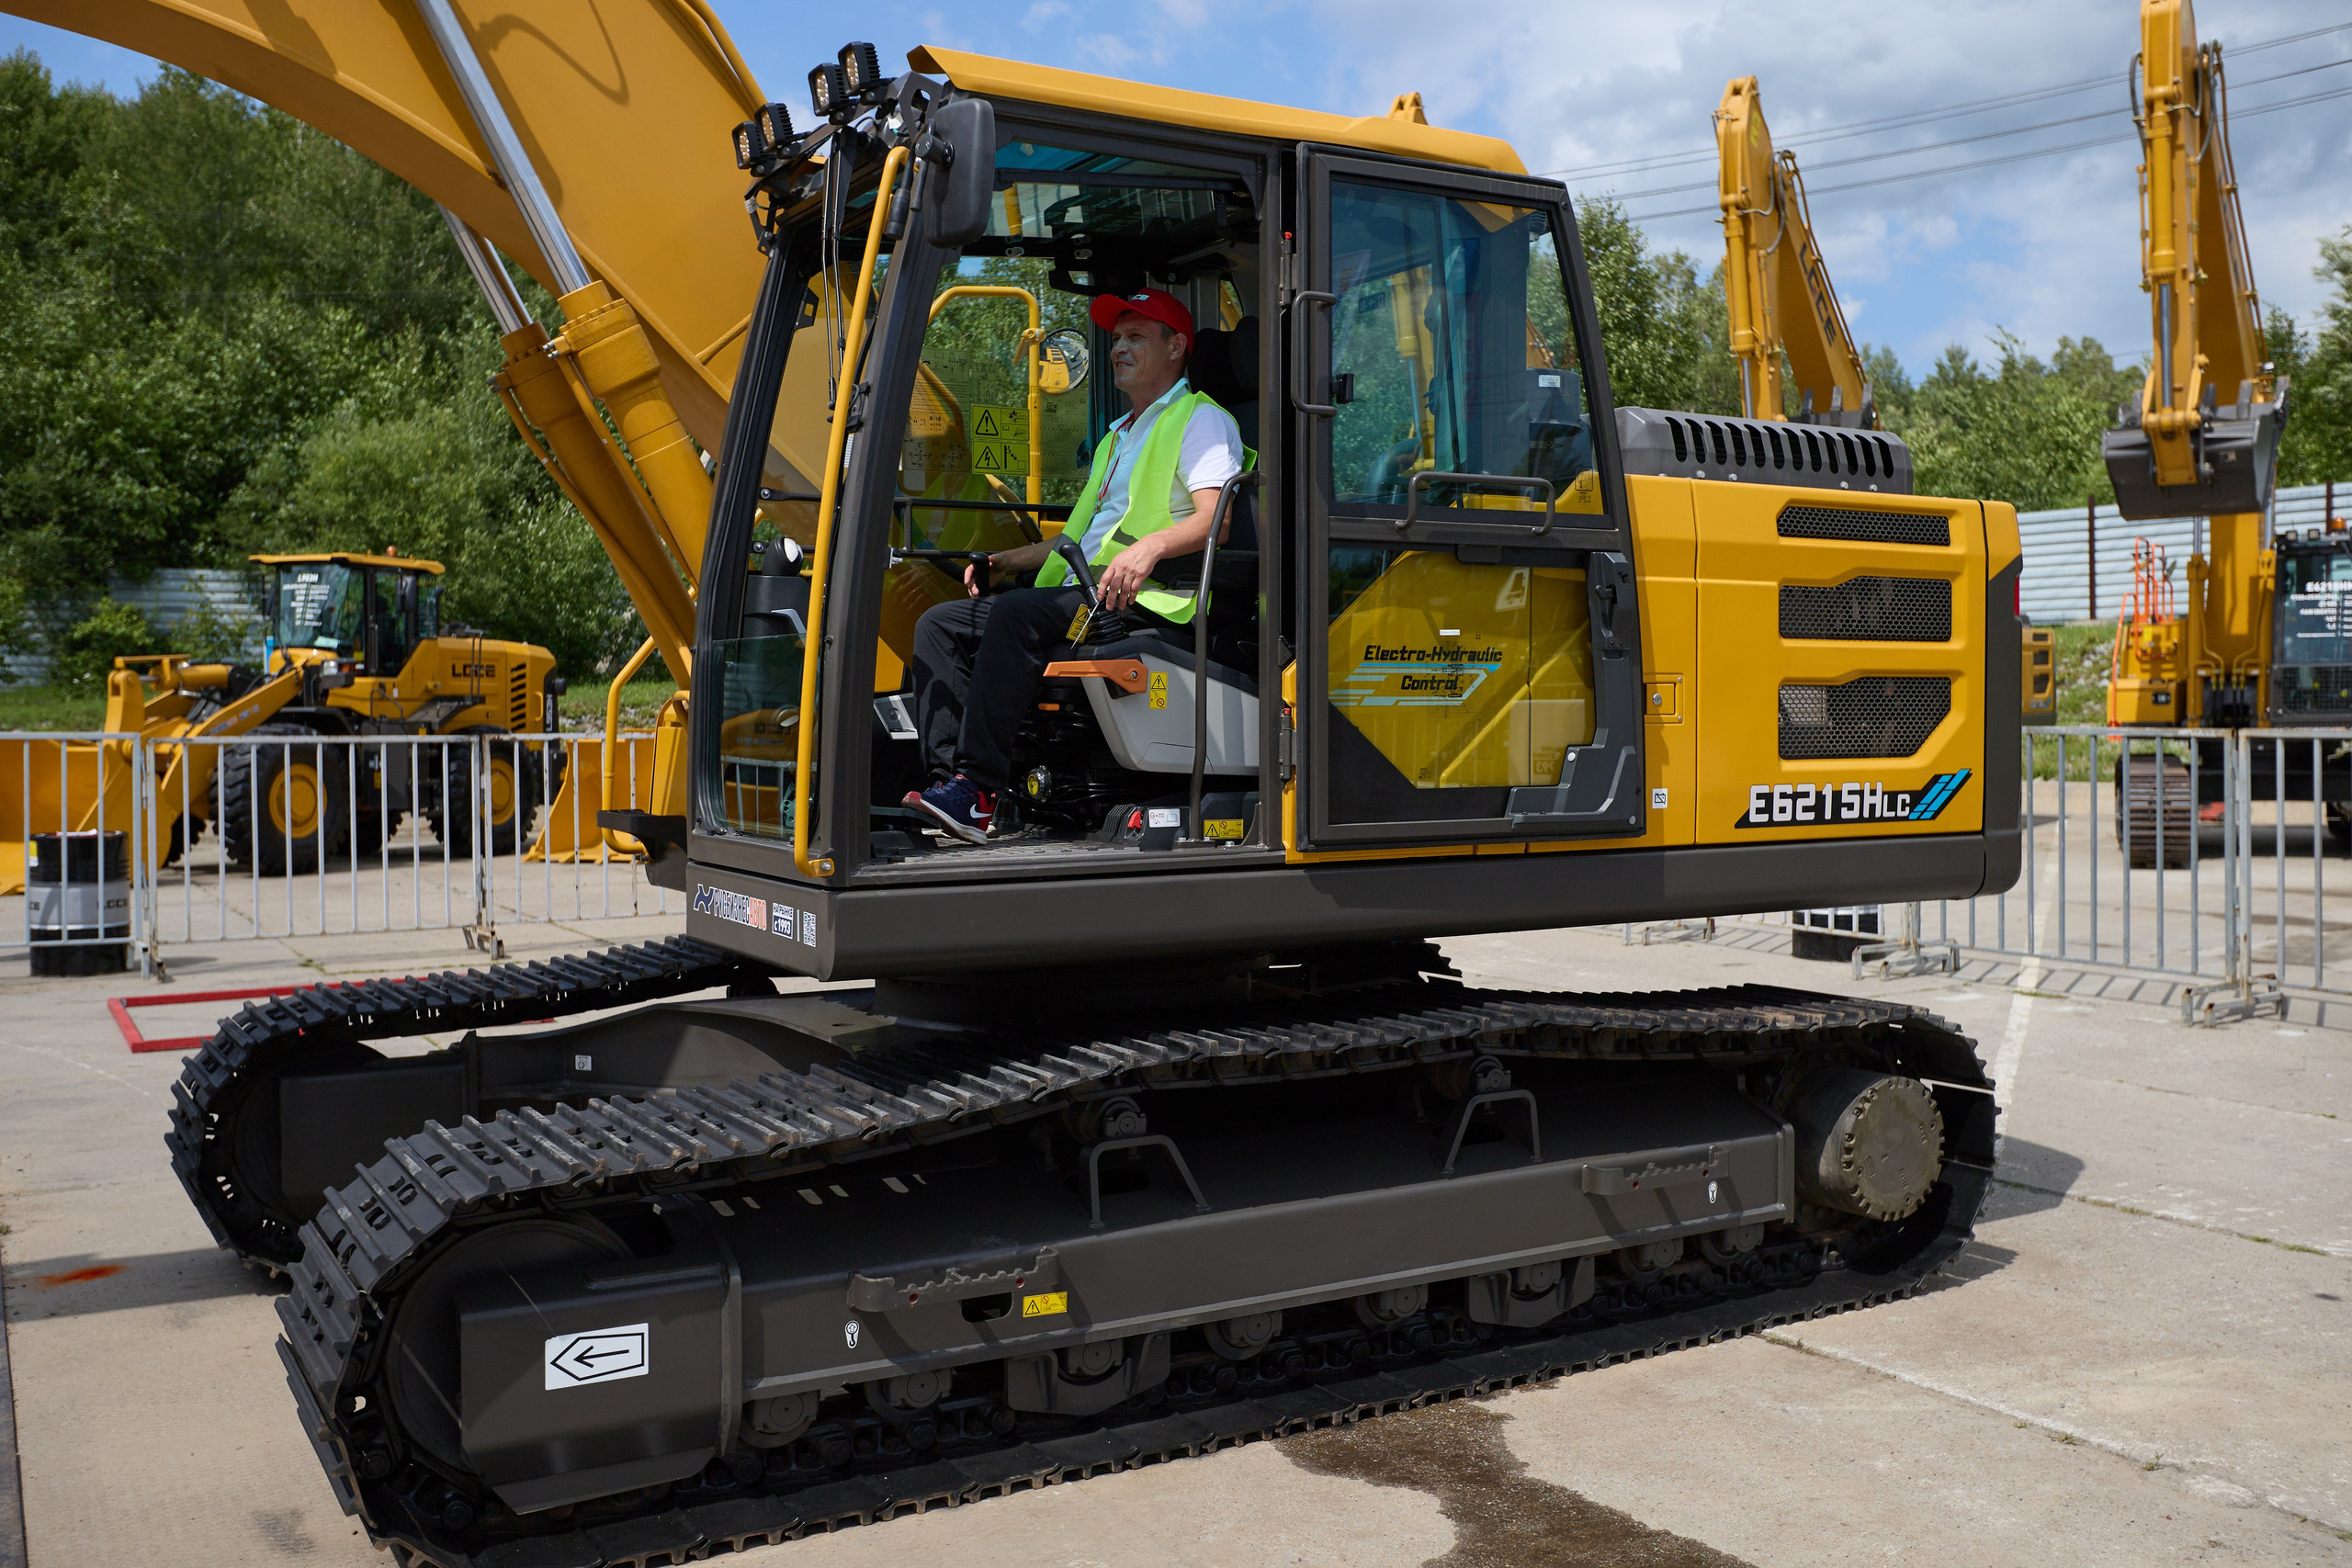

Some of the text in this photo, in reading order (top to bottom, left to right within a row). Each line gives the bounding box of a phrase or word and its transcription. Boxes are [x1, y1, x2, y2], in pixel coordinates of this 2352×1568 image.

[1363, 645, 1503, 662] Electro-Hydraulic
[1401, 675, 1459, 690] Control
[1748, 781, 1910, 823] E6215HLC
[778, 919, 791, 935] 1993
